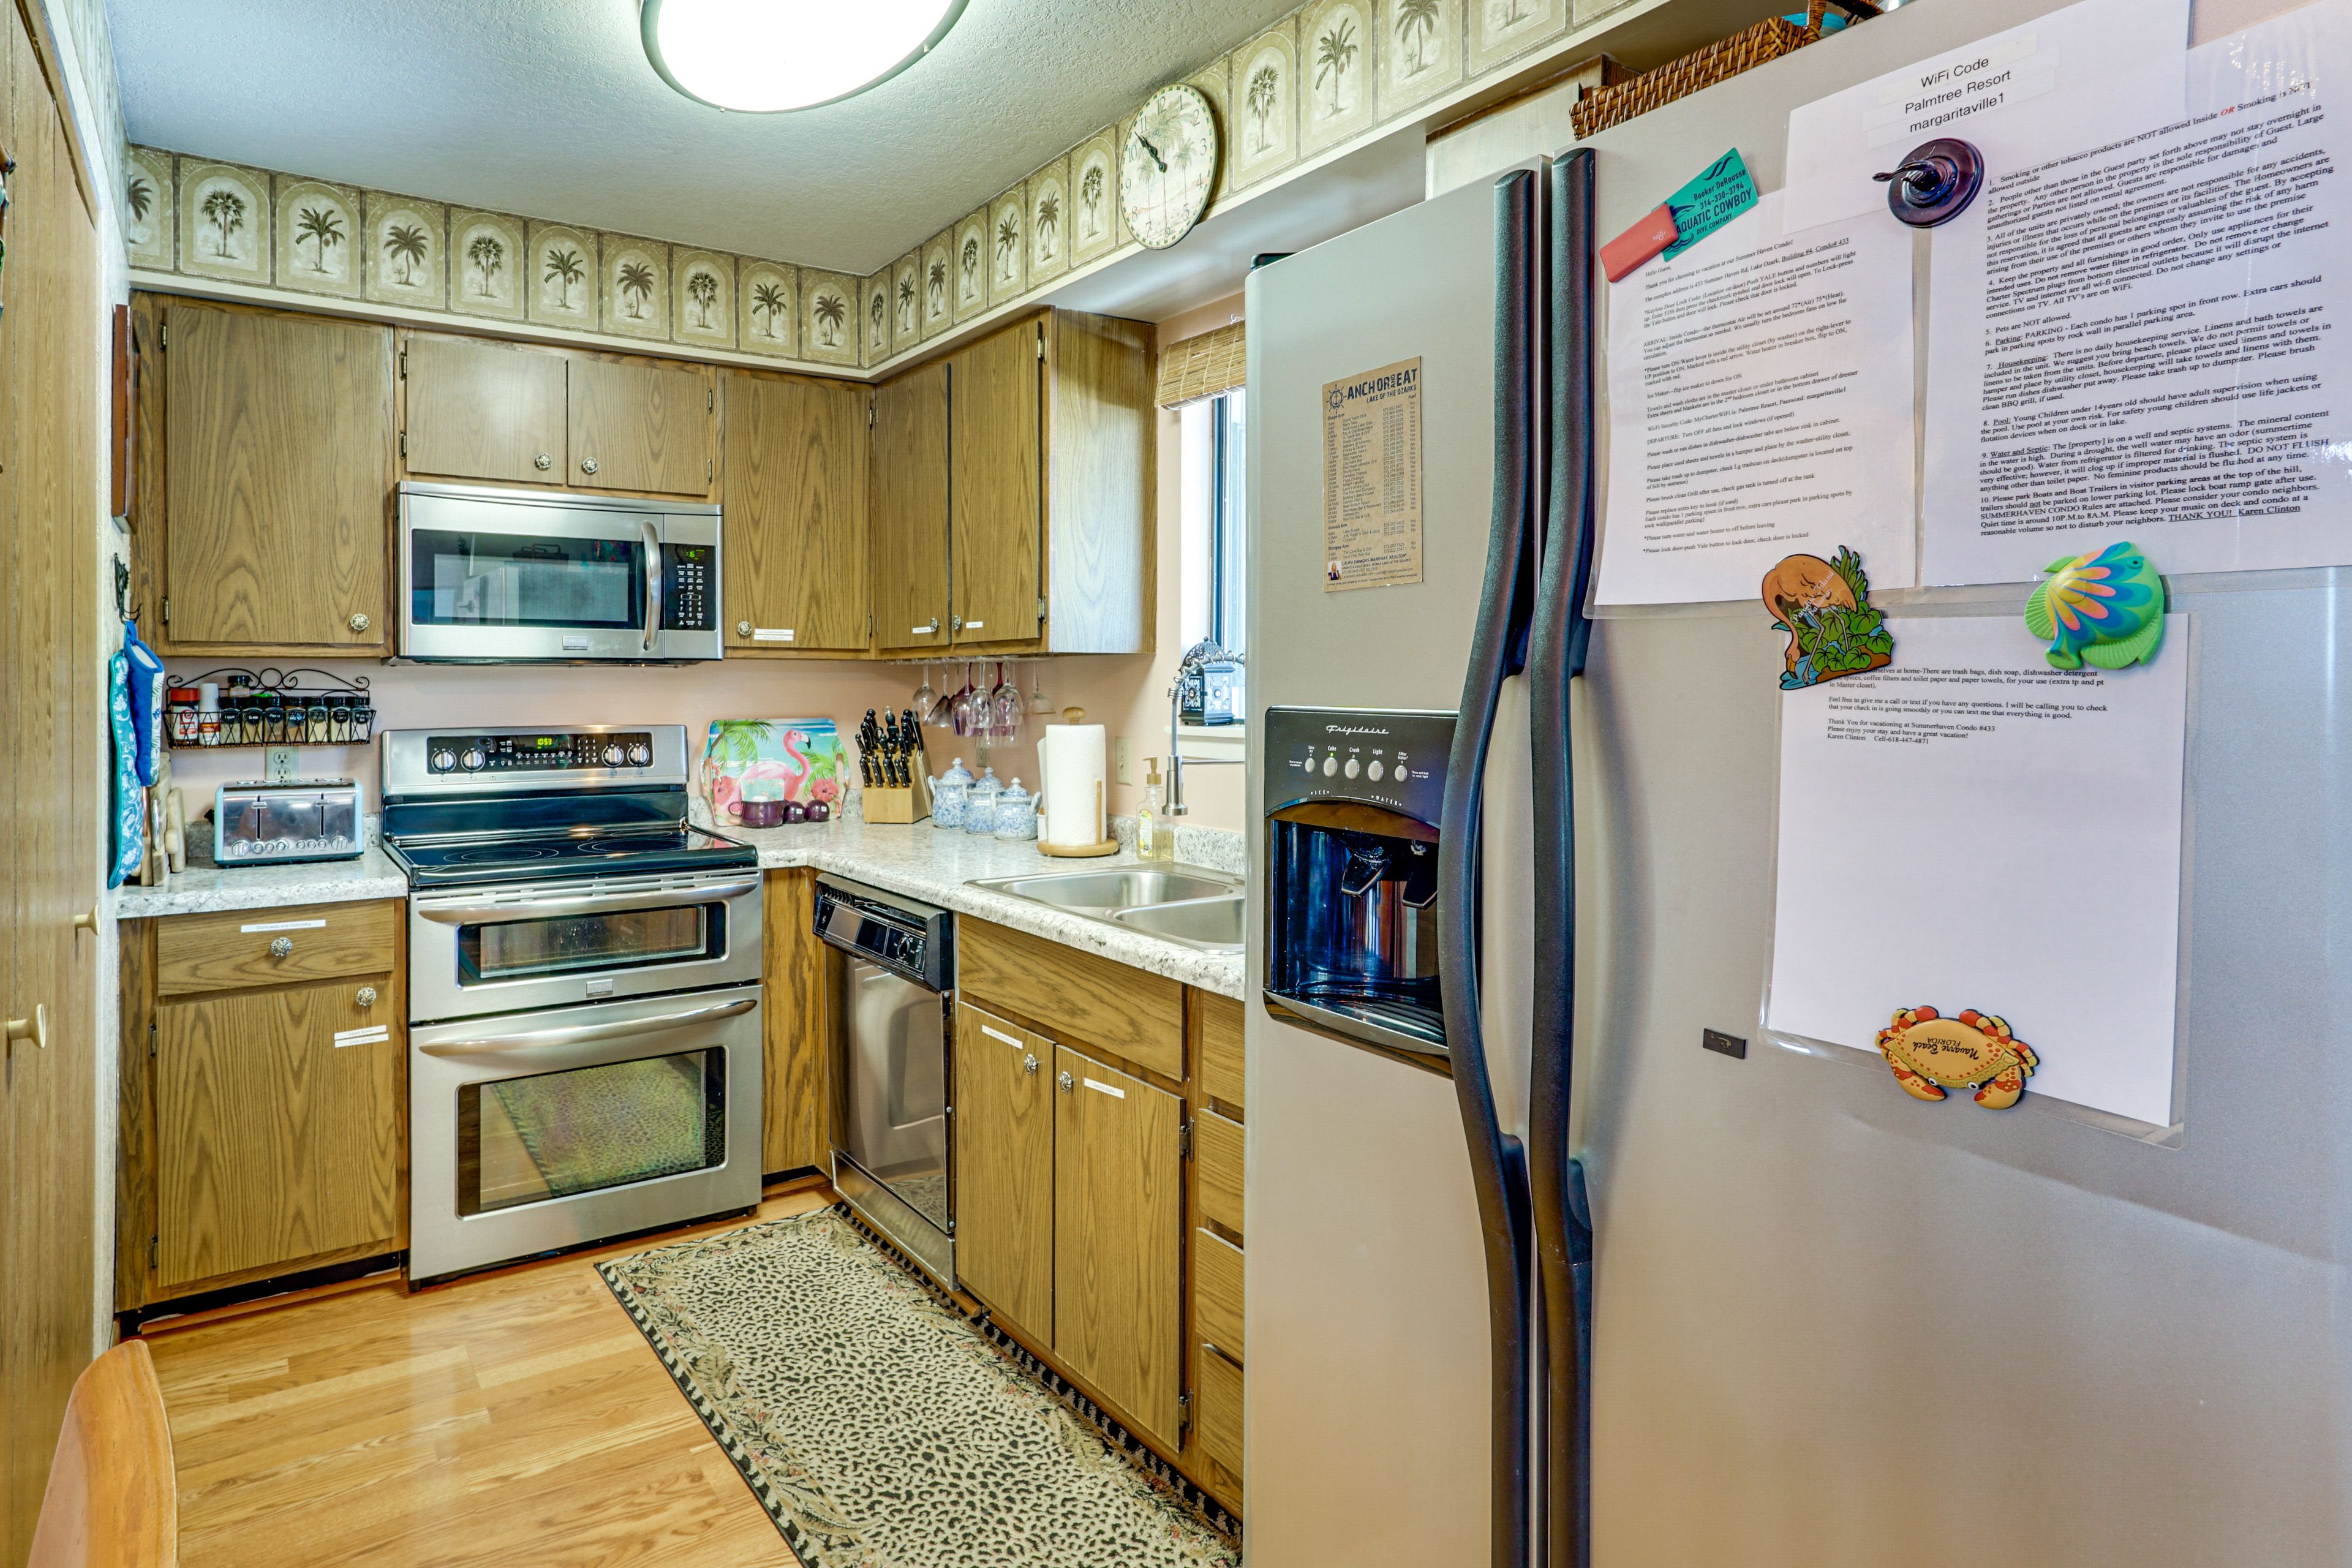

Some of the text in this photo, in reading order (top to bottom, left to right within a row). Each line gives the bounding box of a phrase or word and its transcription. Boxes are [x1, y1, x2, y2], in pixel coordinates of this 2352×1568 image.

[1921, 59, 1989, 88] WiFi Code
[1905, 70, 2011, 114] Palmtree Resort
[1156, 96, 1166, 115] 12
[1178, 95, 1183, 110] 1
[1193, 109, 1200, 127] 2
[1910, 92, 2004, 132] margaritaville1
[1139, 116, 1148, 133] 11
[1200, 138, 1207, 156] 3
[2000, 170, 2030, 183] Smoking
[2041, 161, 2059, 171] other
[2060, 153, 2089, 165] tobacco
[2090, 140, 2123, 158] products
[2122, 136, 2137, 146] are
[2136, 129, 2158, 142] NOT
[2157, 119, 2191, 135] allowed
[2193, 112, 2218, 125] Inside
[2220, 106, 2235, 116] OR
[2237, 94, 2277, 111] Smoking
[1128, 145, 1137, 163] 10
[1126, 178, 1131, 195] 9
[1196, 173, 1203, 189] 4
[1694, 169, 1746, 201] Booker DeRousse
[1988, 175, 2040, 195] allowed outside
[1700, 181, 1744, 209] 314-330-3794
[1131, 206, 1137, 222] 8
[1183, 203, 1189, 221] 5
[1676, 188, 1752, 235] AQUATIC COWBOY
[1146, 222, 1152, 238] 7
[1165, 227, 1171, 238] 6
[1697, 213, 1732, 235] DIVE COMPANY
[1645, 282, 1659, 290] Thank
[1675, 271, 1695, 281] choosing
[1701, 263, 1721, 272] vacation
[1735, 251, 1757, 262] Summer
[1756, 246, 1773, 255] Haven
[1773, 239, 1793, 250] Condo!
[1653, 291, 1672, 300] complex
[1672, 286, 1689, 295] address
[1703, 275, 1724, 285] Summer
[1724, 270, 1740, 279] Haven
[1763, 257, 1781, 267] Ozark,
[1781, 251, 1805, 263] Building
[1804, 247, 1814, 257] #4,
[1815, 241, 1838, 253] Condo#
[1837, 237, 1850, 247] 433
[2022, 318, 2041, 328] NOT
[2041, 312, 2073, 324] allowed.
[1348, 377, 1390, 401] ANCHOR
[1396, 368, 1417, 386] EAT
[1366, 394, 1378, 403] LAKE
[1397, 385, 1416, 394] OZARKS
[1980, 508, 2046, 520] SUMMERHAVEN
[2048, 505, 2080, 514] CONDO
[2118, 498, 2153, 508] attached.
[2182, 492, 2218, 502] consider
[2220, 491, 2241, 500] your
[2242, 488, 2270, 497] condo
[2272, 484, 2320, 494] neighbors.
[1980, 527, 2017, 536] reasonable
[2078, 520, 2105, 529] disturb
[2125, 516, 2166, 526] neighbors.
[2168, 513, 2205, 522] THANK
[2207, 510, 2232, 520] YOU!
[2238, 508, 2266, 517] Karen
[2266, 505, 2301, 515] Clinton
[1790, 571, 1835, 625] Paradise Island
[1809, 588, 1833, 616] Bahamas
[1326, 725, 1389, 735] Frigidaire
[1827, 725, 1845, 734] Please
[1845, 726, 1862, 736] enjoy
[1862, 728, 1877, 737] your
[1875, 729, 1889, 737] stay
[1889, 729, 1901, 738] and
[1922, 731, 1939, 740] great
[1869, 720, 1903, 729] vacationing
[1911, 722, 1955, 730] Summerhaven
[1874, 736, 1929, 745] Cell-618-447-4871
[1376, 796, 1398, 806] WATER
[1912, 1041, 1979, 1060] Navarre Beach
[1927, 1037, 1961, 1047] FLORIDA
